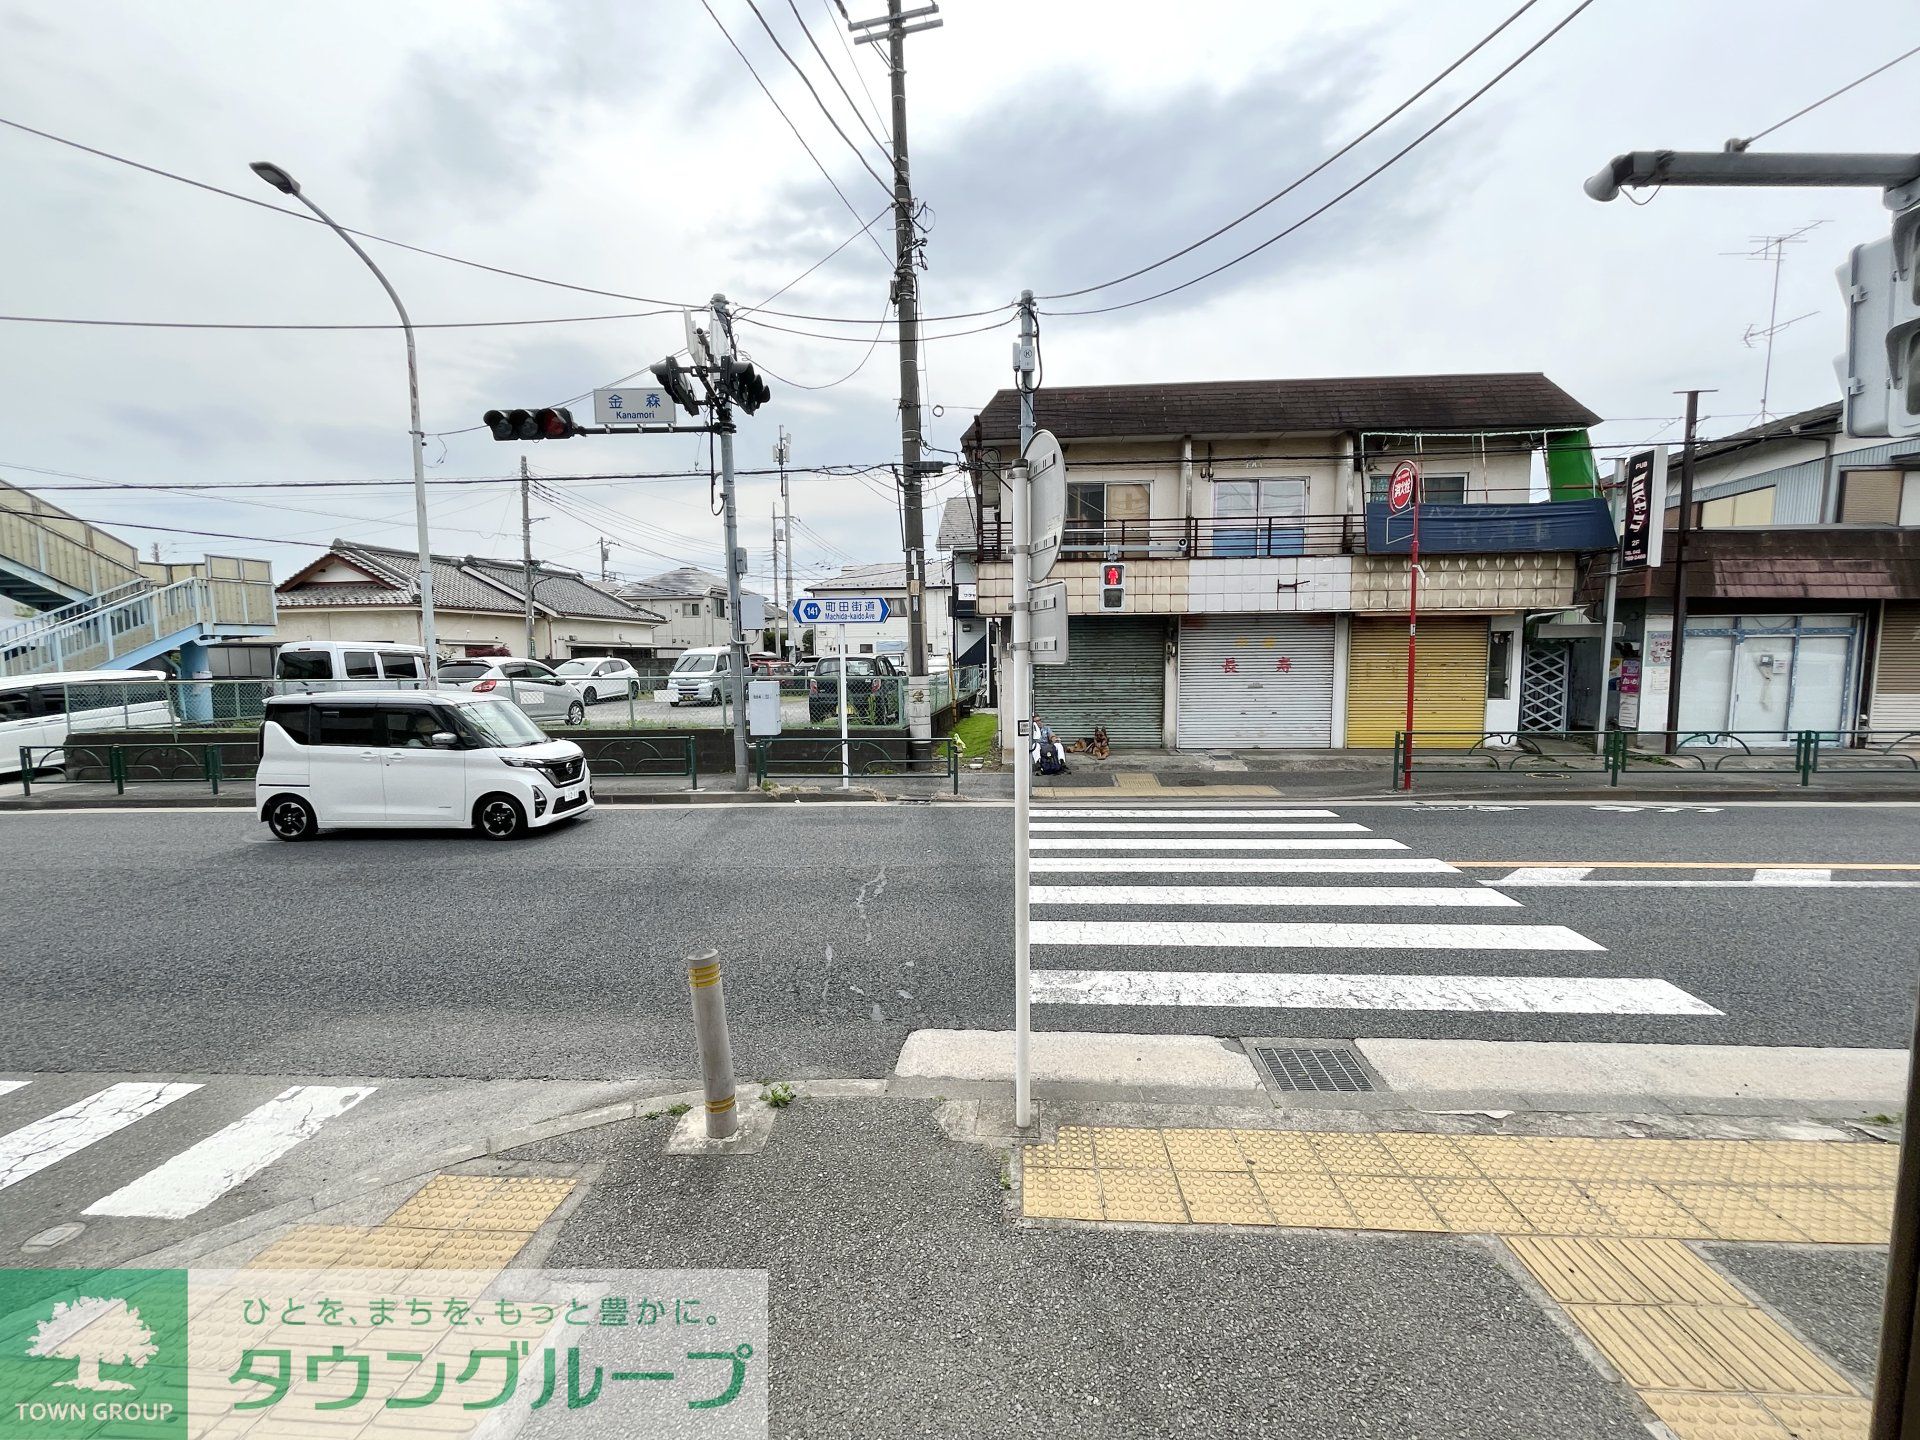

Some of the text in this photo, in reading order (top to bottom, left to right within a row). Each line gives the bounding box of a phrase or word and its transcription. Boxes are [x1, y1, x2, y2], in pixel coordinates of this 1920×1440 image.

[608, 393, 661, 409] 金森
[616, 411, 655, 419] Kanamori
[1635, 461, 1648, 470] PUB
[1394, 478, 1411, 498] 消火栓
[825, 601, 875, 612] 町田街道
[806, 607, 818, 616] 141
[825, 612, 865, 620] Machida-kaido
